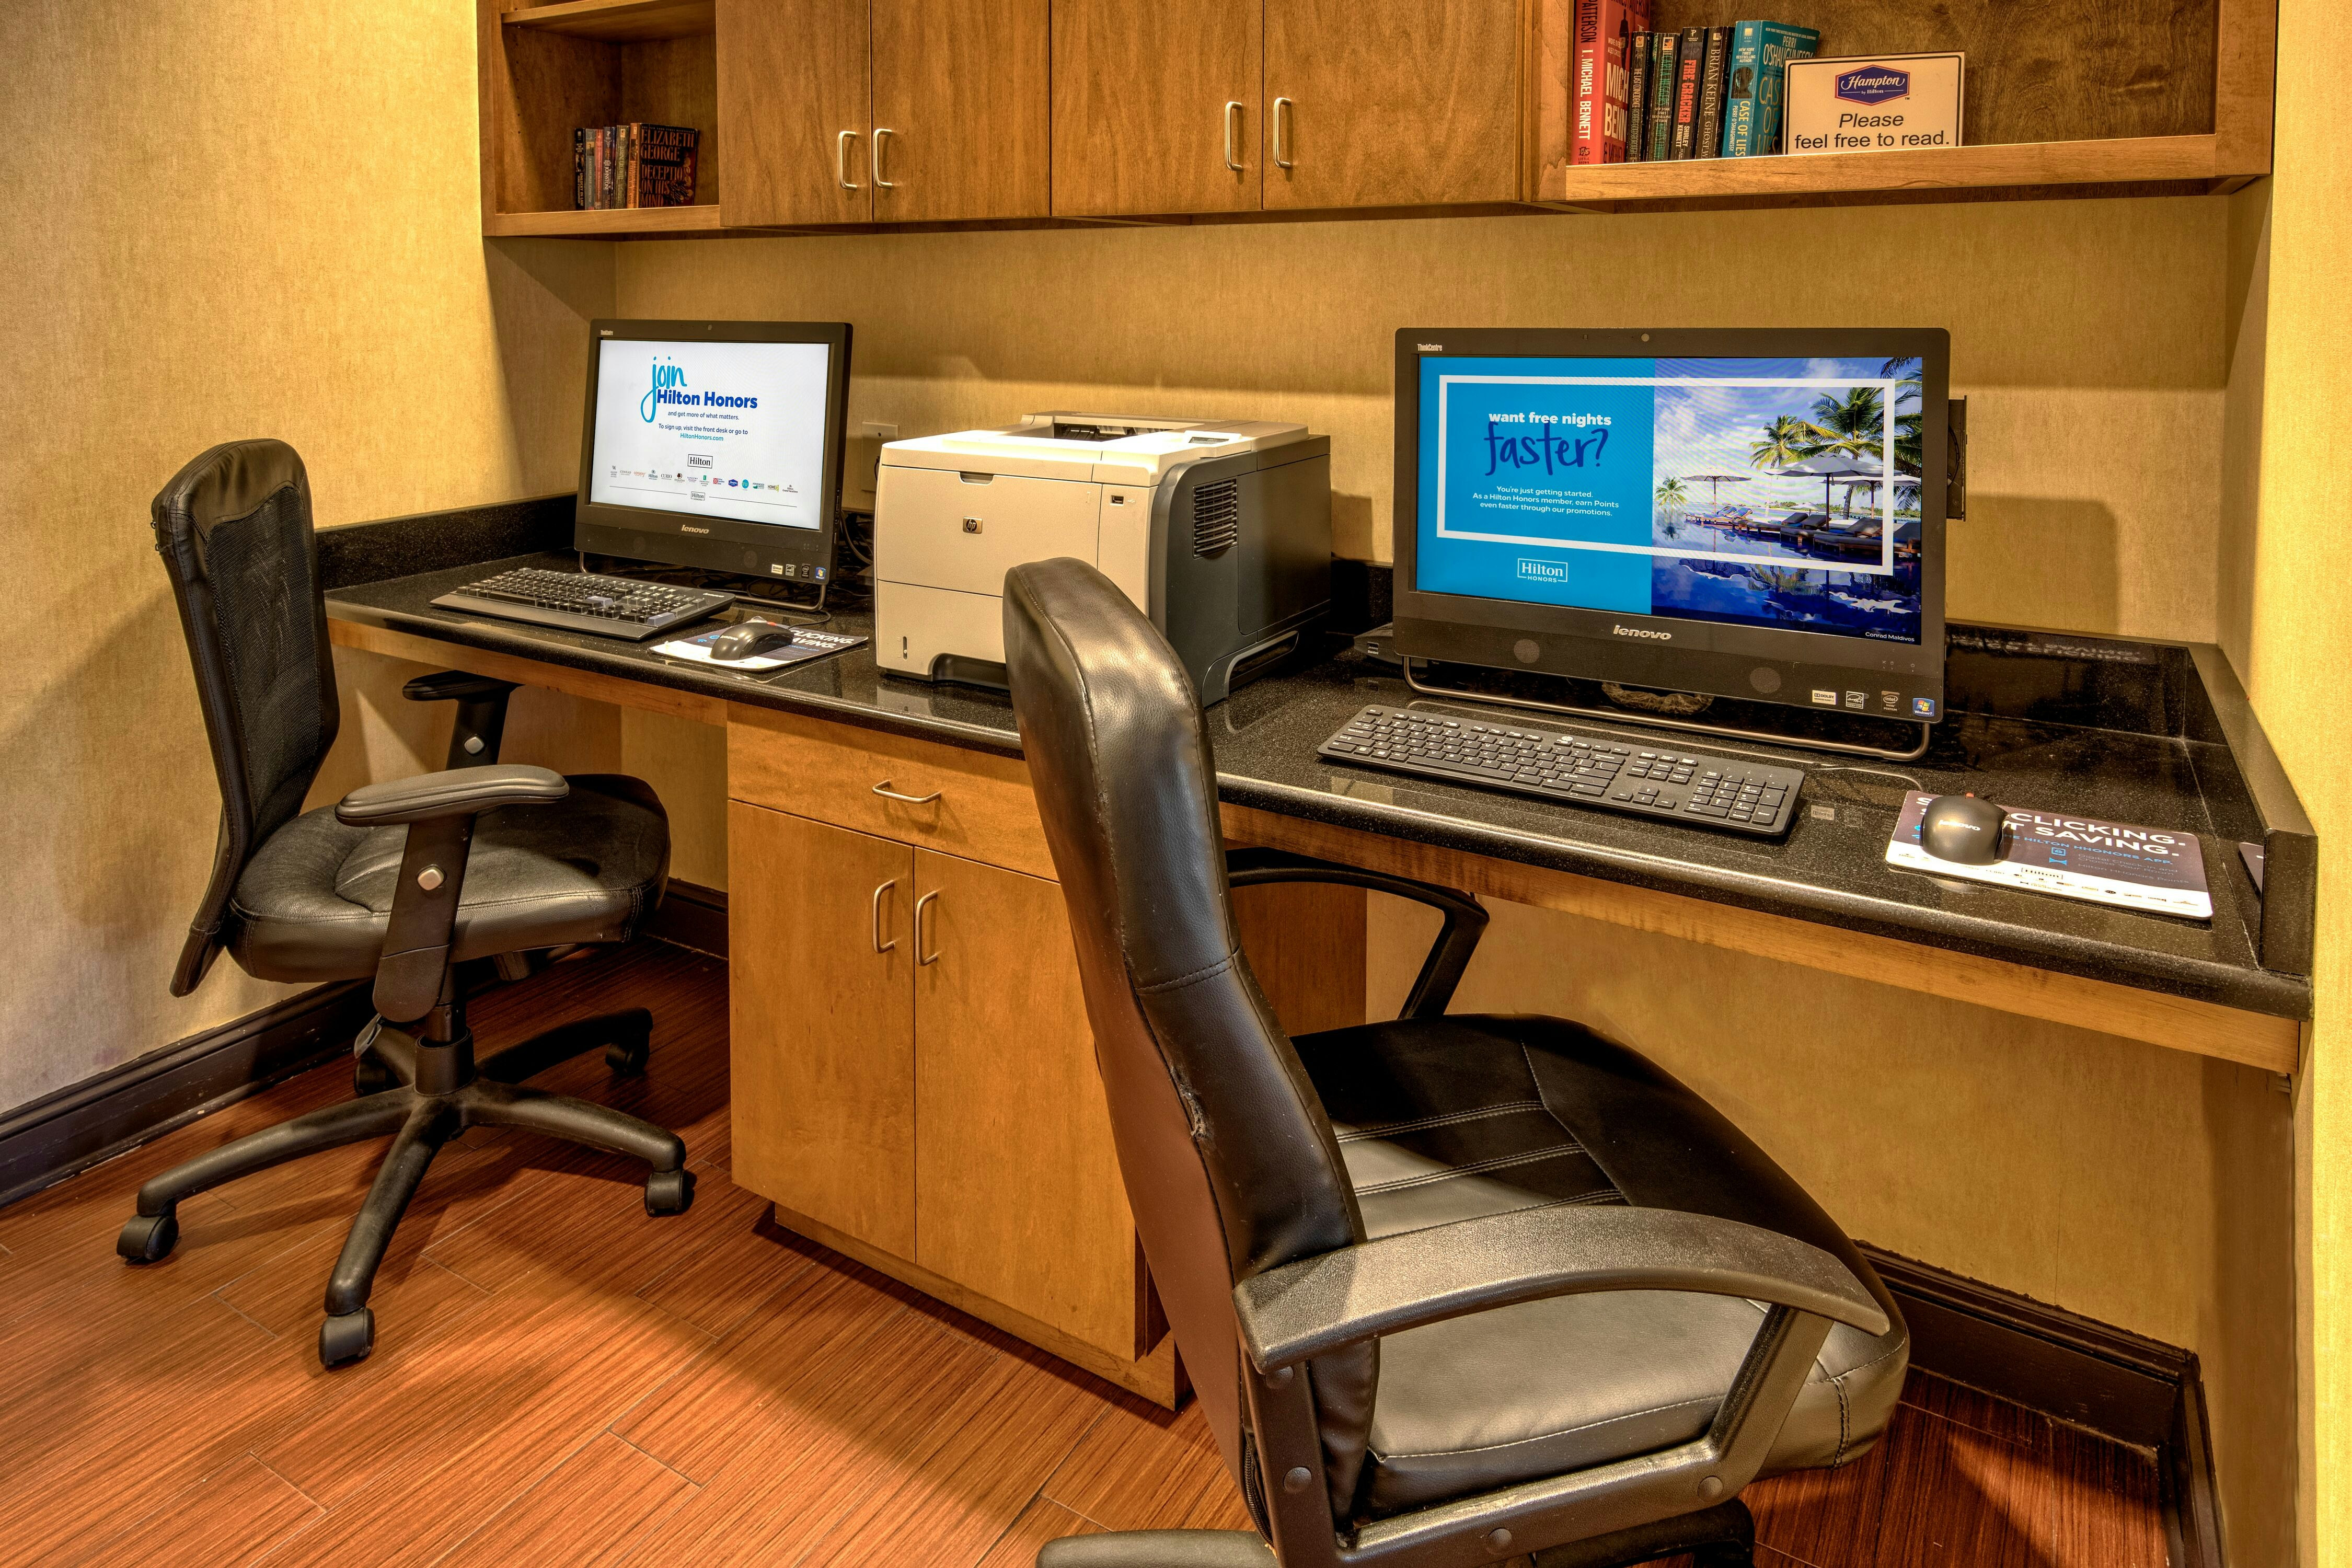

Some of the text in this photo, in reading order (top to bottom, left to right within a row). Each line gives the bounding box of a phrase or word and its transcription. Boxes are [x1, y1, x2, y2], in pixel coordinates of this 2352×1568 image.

[1783, 36, 1796, 48] PERRI
[1708, 49, 1721, 82] BRIAN
[1580, 59, 1593, 97] MICHAEL
[1841, 75, 1905, 90] Hampton
[1678, 60, 1697, 123] FIRE CRACKER
[1704, 84, 1716, 116] KEENE
[1578, 101, 1592, 140] BENNETT
[1735, 101, 1750, 156] CASE OF LIES
[1839, 113, 1904, 128] Please
[641, 129, 695, 147] ELIZABETH
[1702, 121, 1712, 150] GHOST
[1795, 131, 1949, 149] feel free to read.
[641, 144, 680, 161] GEORGE
[641, 179, 670, 195] ON HIS
[641, 356, 687, 423] join
[657, 389, 758, 409] Hilton Honors
[1489, 412, 1611, 428] want free nights
[680, 433, 724, 441] HiltonHonors.com
[1483, 420, 1608, 476] faster?
[690, 457, 710, 466] Hilton
[1521, 504, 1550, 513] through
[1566, 508, 1612, 516] promotions.
[1541, 497, 1574, 505] member,
[682, 525, 709, 534] lenovo
[1522, 562, 1563, 577] Hilton
[1613, 625, 1671, 640] lenovo
[2010, 813, 2185, 846] CLICKING.
[2024, 837, 2069, 848] HILTON
[2074, 845, 2140, 860] HHONORS
[2035, 827, 2179, 856] SAVING.
[2078, 854, 2109, 862] Digital
